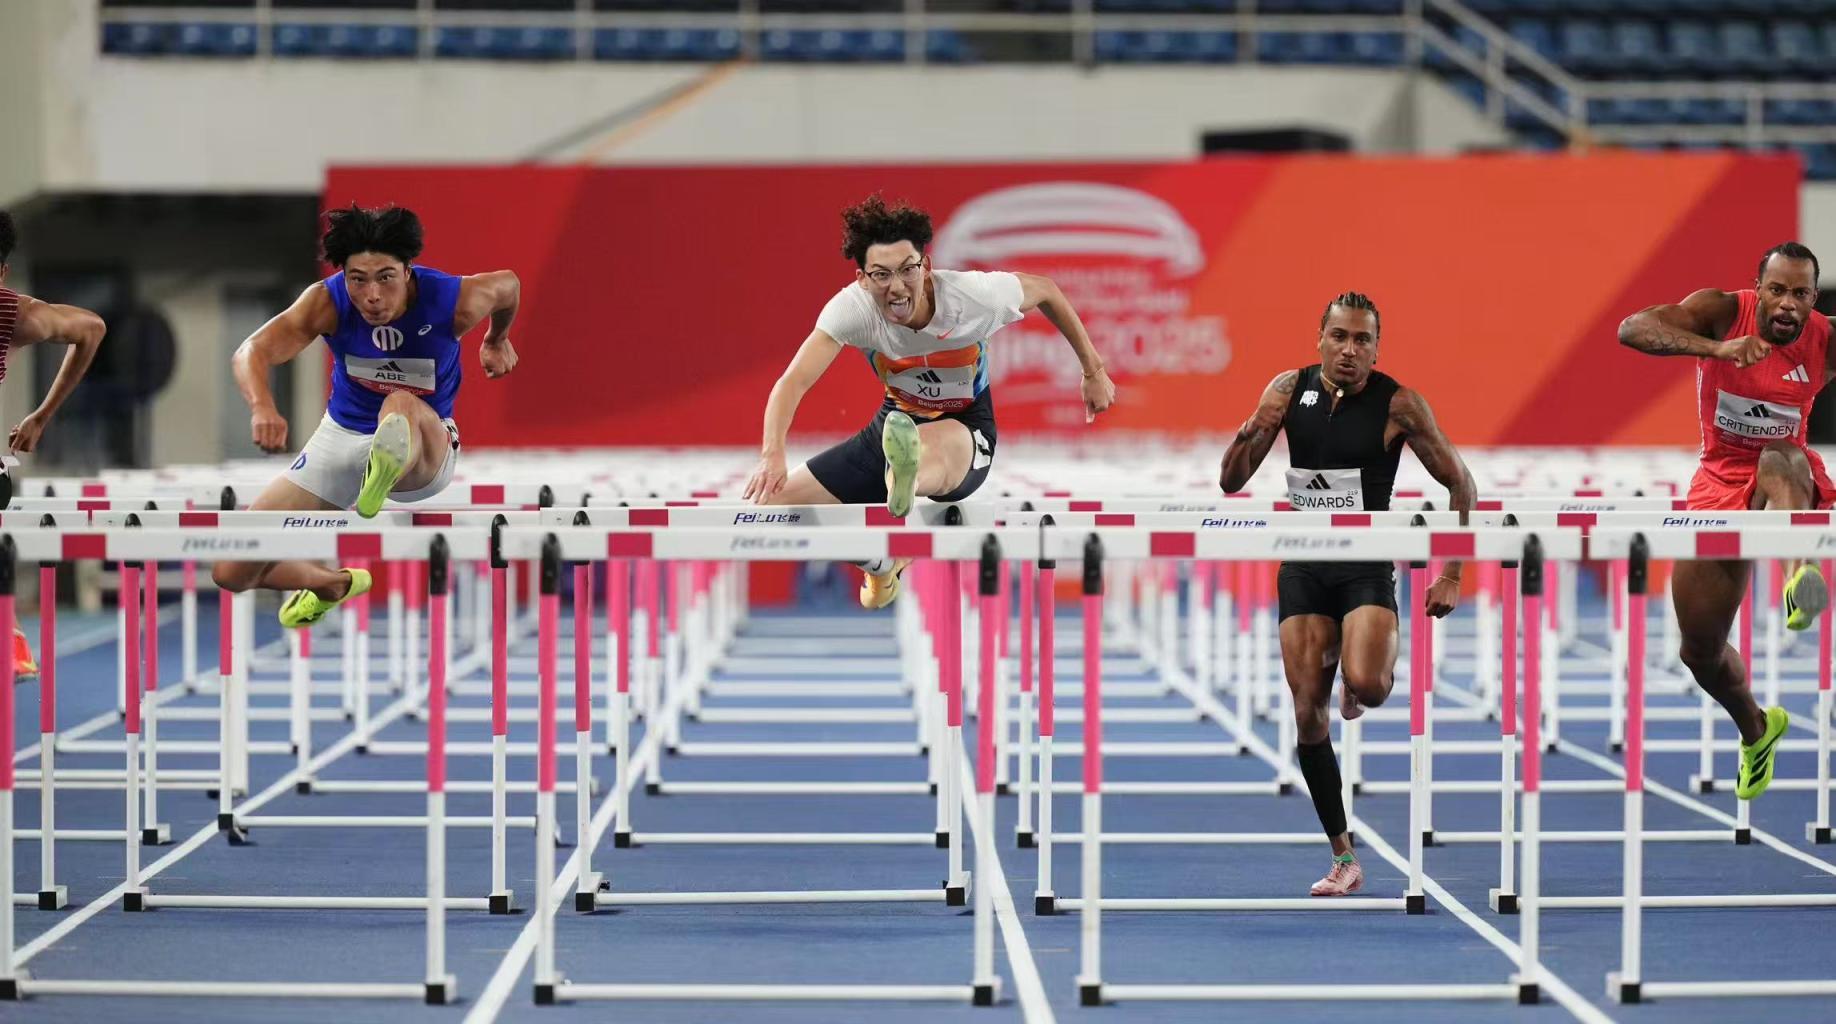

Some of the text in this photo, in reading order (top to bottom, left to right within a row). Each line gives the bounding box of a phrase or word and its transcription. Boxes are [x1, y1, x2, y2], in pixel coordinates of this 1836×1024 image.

[375, 372, 406, 381] ABE
[917, 384, 940, 397] XU
[1718, 416, 1795, 436] CRITTENDEN
[1293, 494, 1354, 508] EDWARDS
